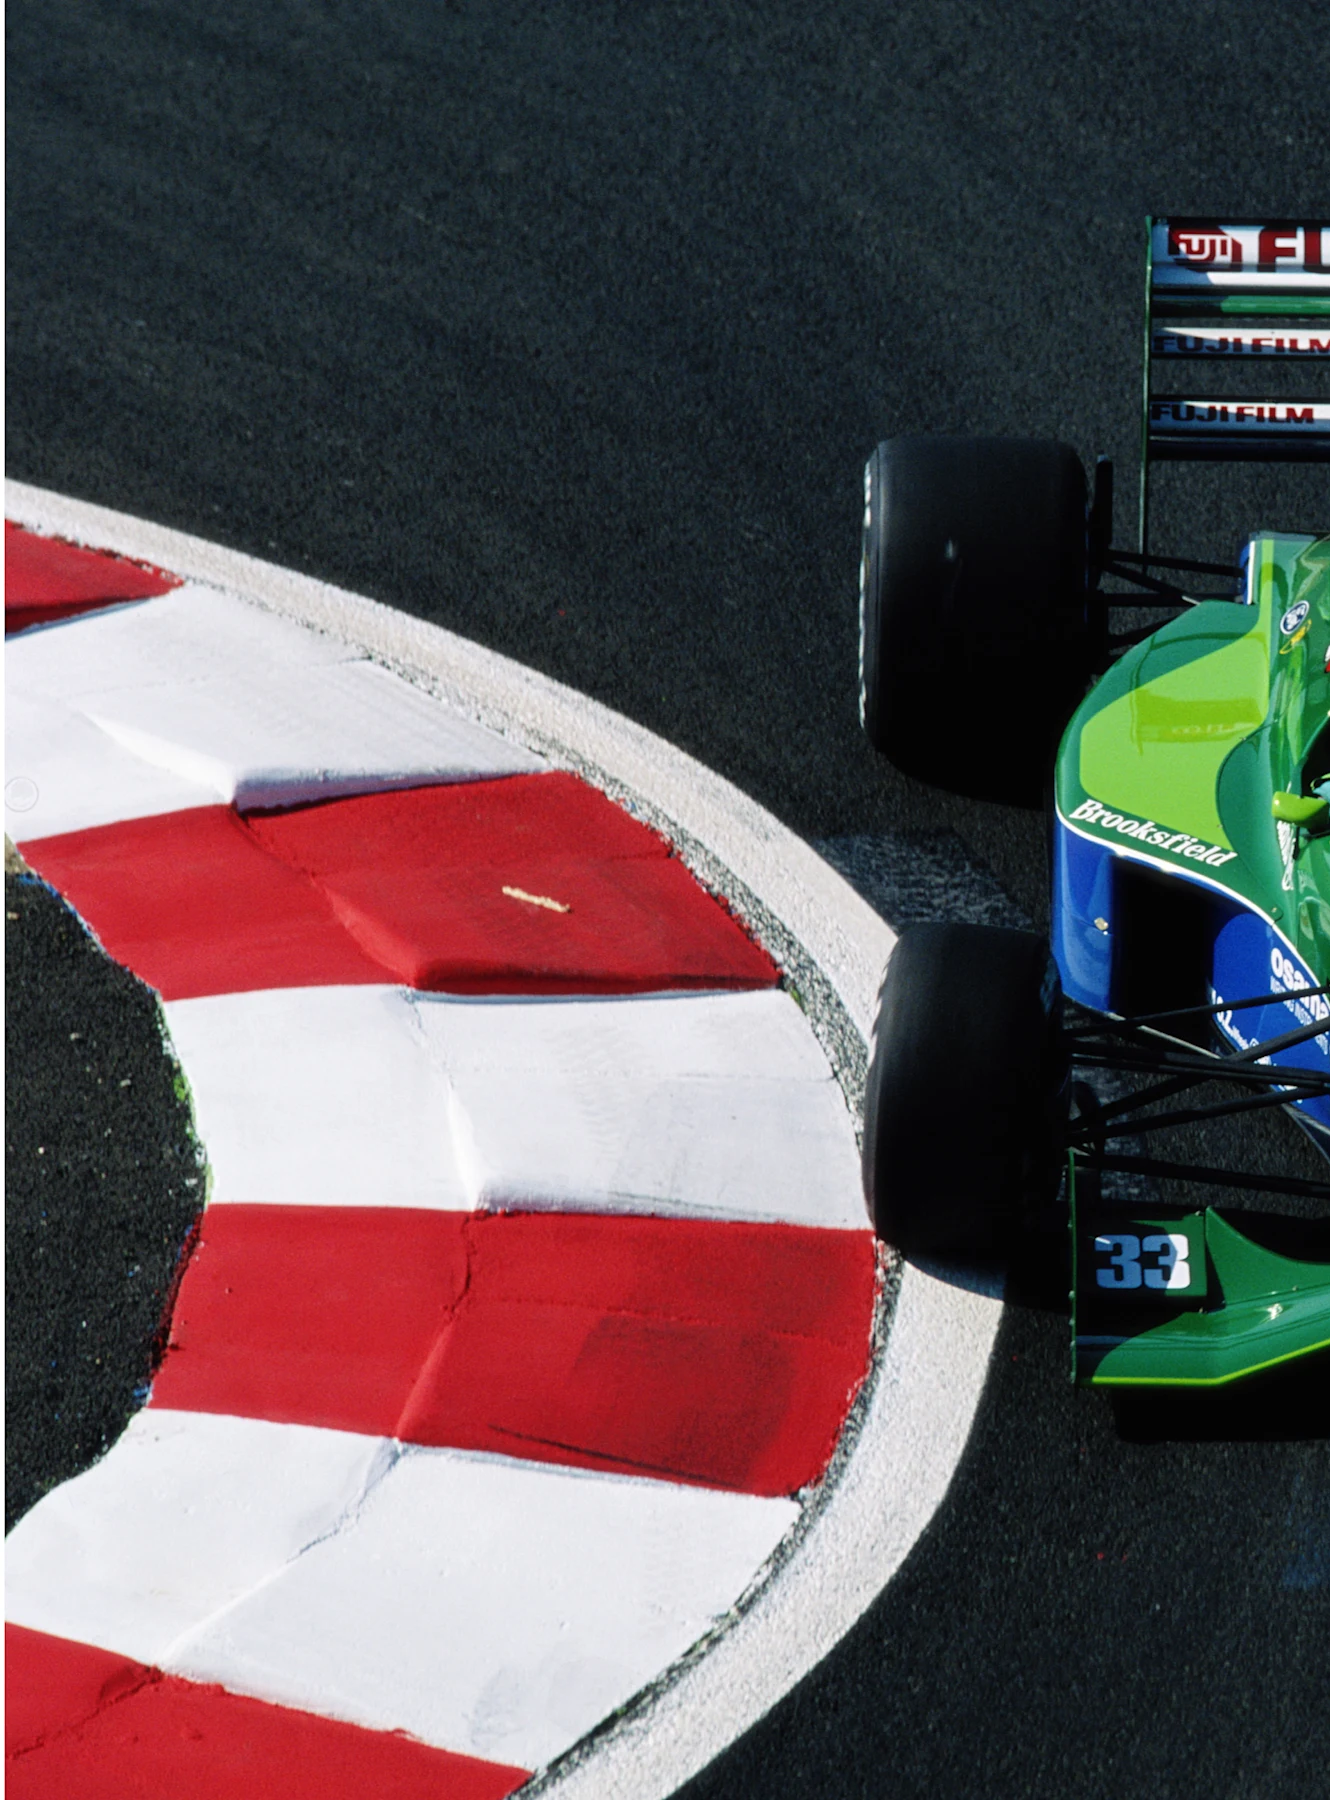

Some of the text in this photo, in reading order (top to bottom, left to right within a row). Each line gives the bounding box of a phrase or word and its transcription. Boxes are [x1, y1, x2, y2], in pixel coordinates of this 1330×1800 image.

[1152, 403, 1315, 424] FUJIFILM
[1069, 798, 1237, 868] Brooksfield
[1095, 1234, 1191, 1289] 33
